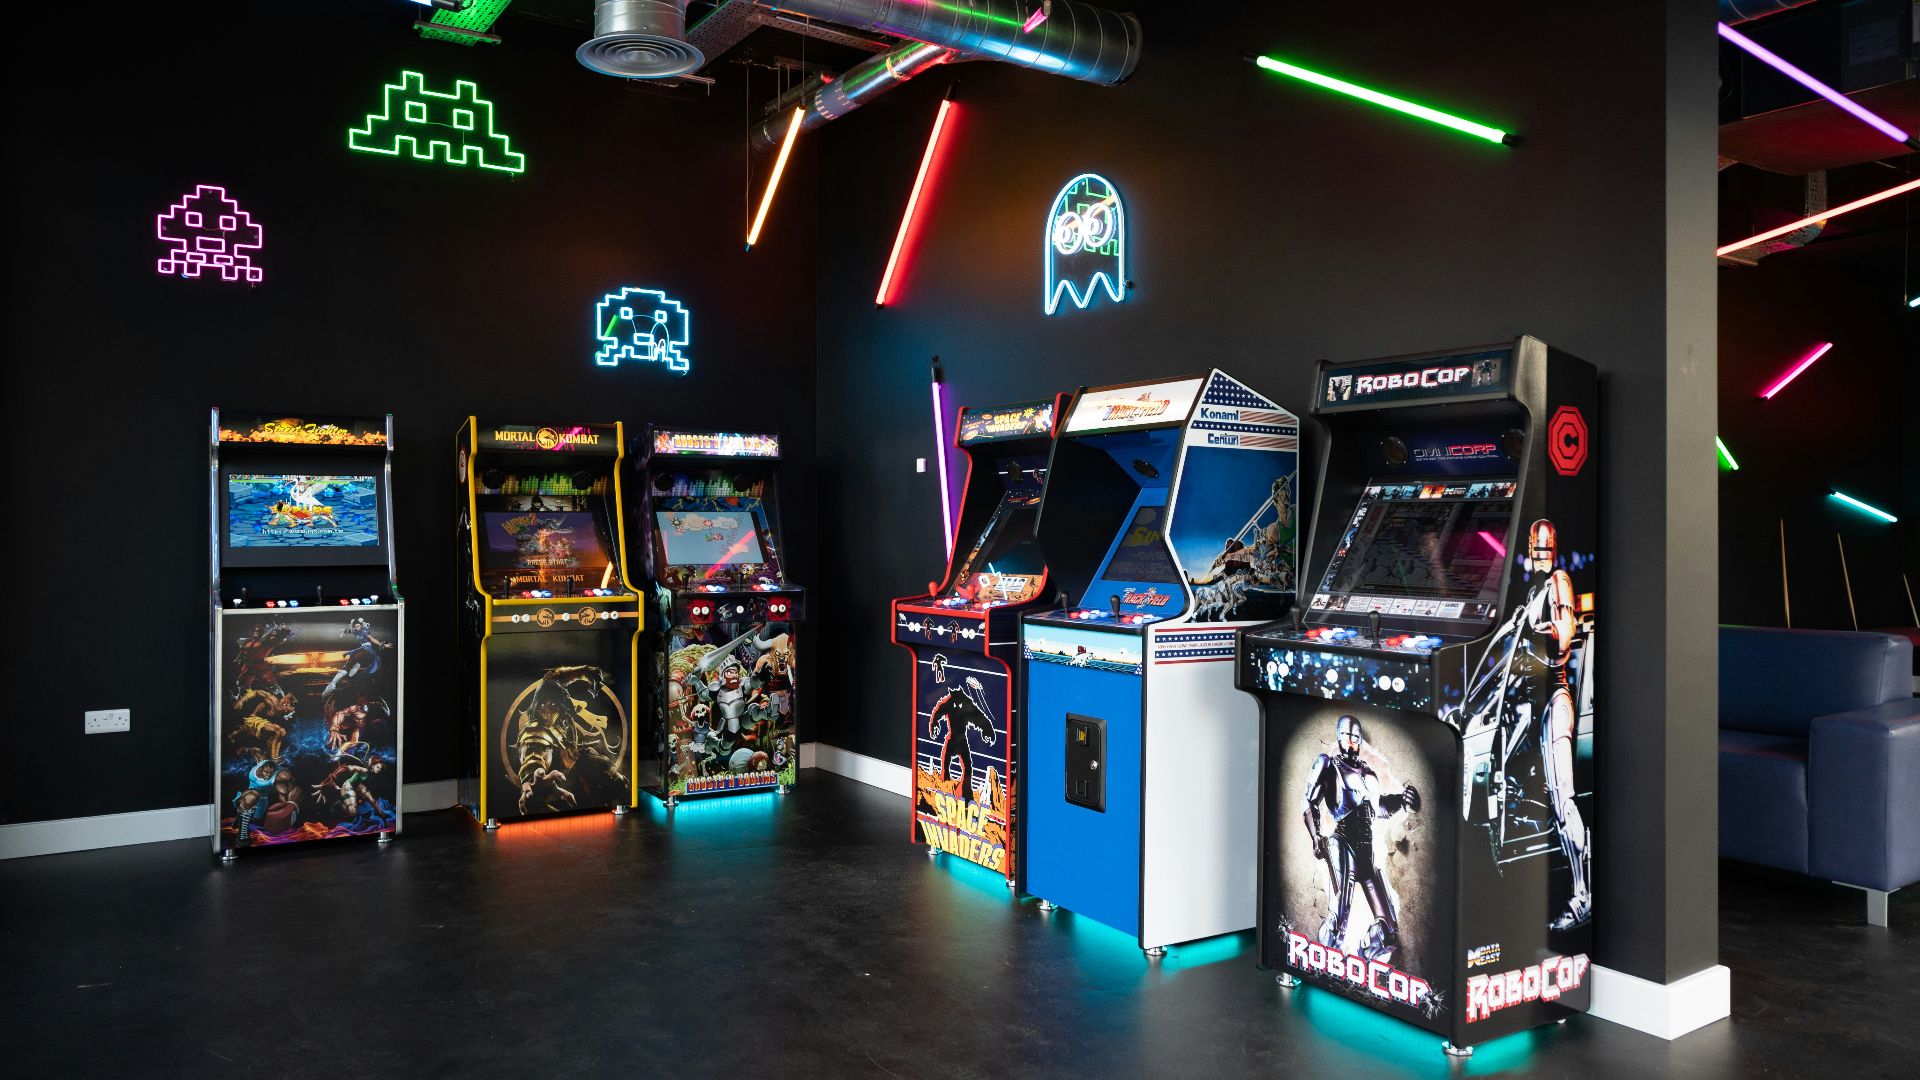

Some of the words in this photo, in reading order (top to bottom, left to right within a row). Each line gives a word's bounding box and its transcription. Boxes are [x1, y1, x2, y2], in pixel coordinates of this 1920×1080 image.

[994, 412, 1022, 425] SPACE
[1200, 408, 1239, 421] Konami
[263, 423, 300, 435] Street
[301, 423, 348, 436] Fighter
[495, 431, 535, 442] MORTAL
[559, 434, 599, 445] KOMBAT
[1207, 433, 1239, 446] Centuri
[517, 575, 547, 583] MORTAL
[688, 777, 725, 792] GHOSTS
[738, 770, 776, 786] GOBLINS
[934, 789, 991, 839] SPACE
[917, 819, 1006, 871] INVADERS
[1480, 943, 1501, 955] DATA
[1480, 952, 1501, 966] EAST
